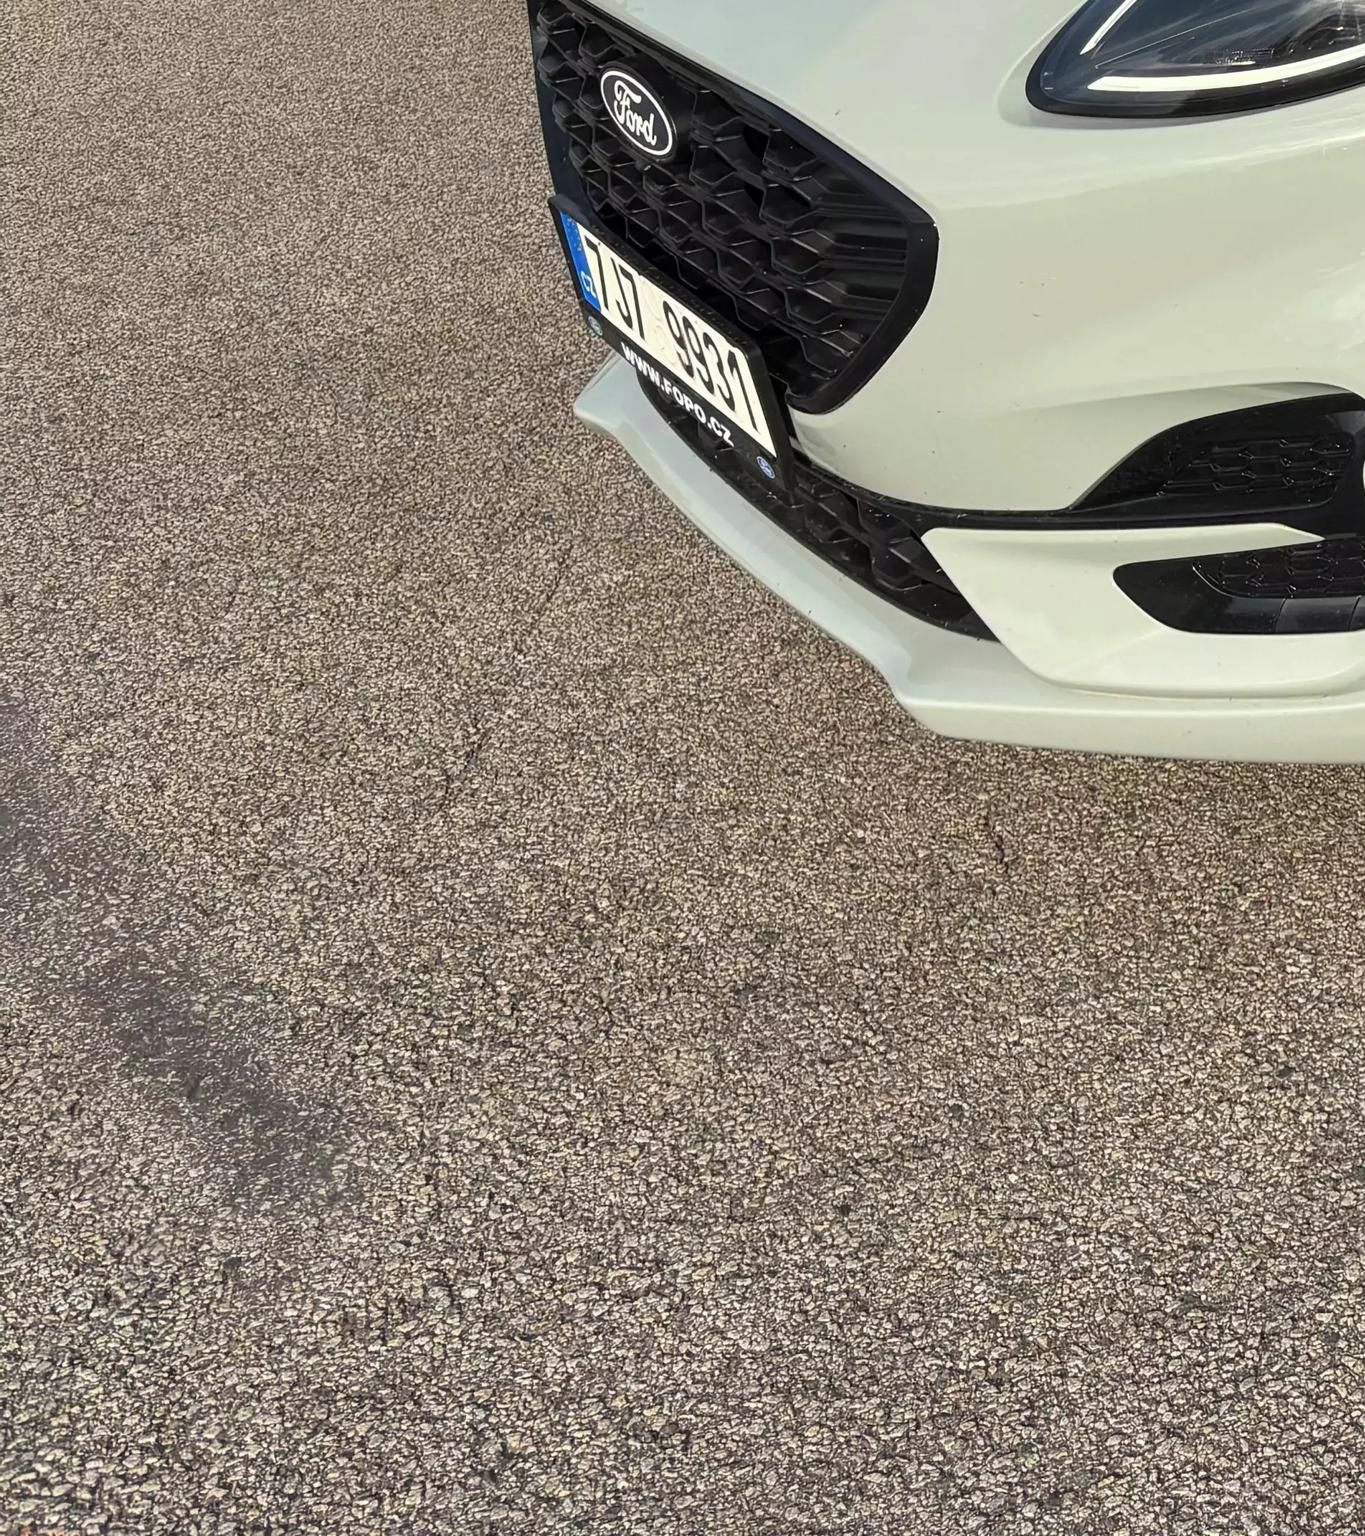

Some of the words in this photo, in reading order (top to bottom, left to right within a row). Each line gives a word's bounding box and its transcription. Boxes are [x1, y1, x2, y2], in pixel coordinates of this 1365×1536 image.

[614, 80, 658, 146] Ford
[580, 270, 597, 299] CZ
[584, 239, 646, 341] 7J7
[662, 300, 760, 433] 9931
[620, 341, 735, 448] WWW.FOPO.CZ
